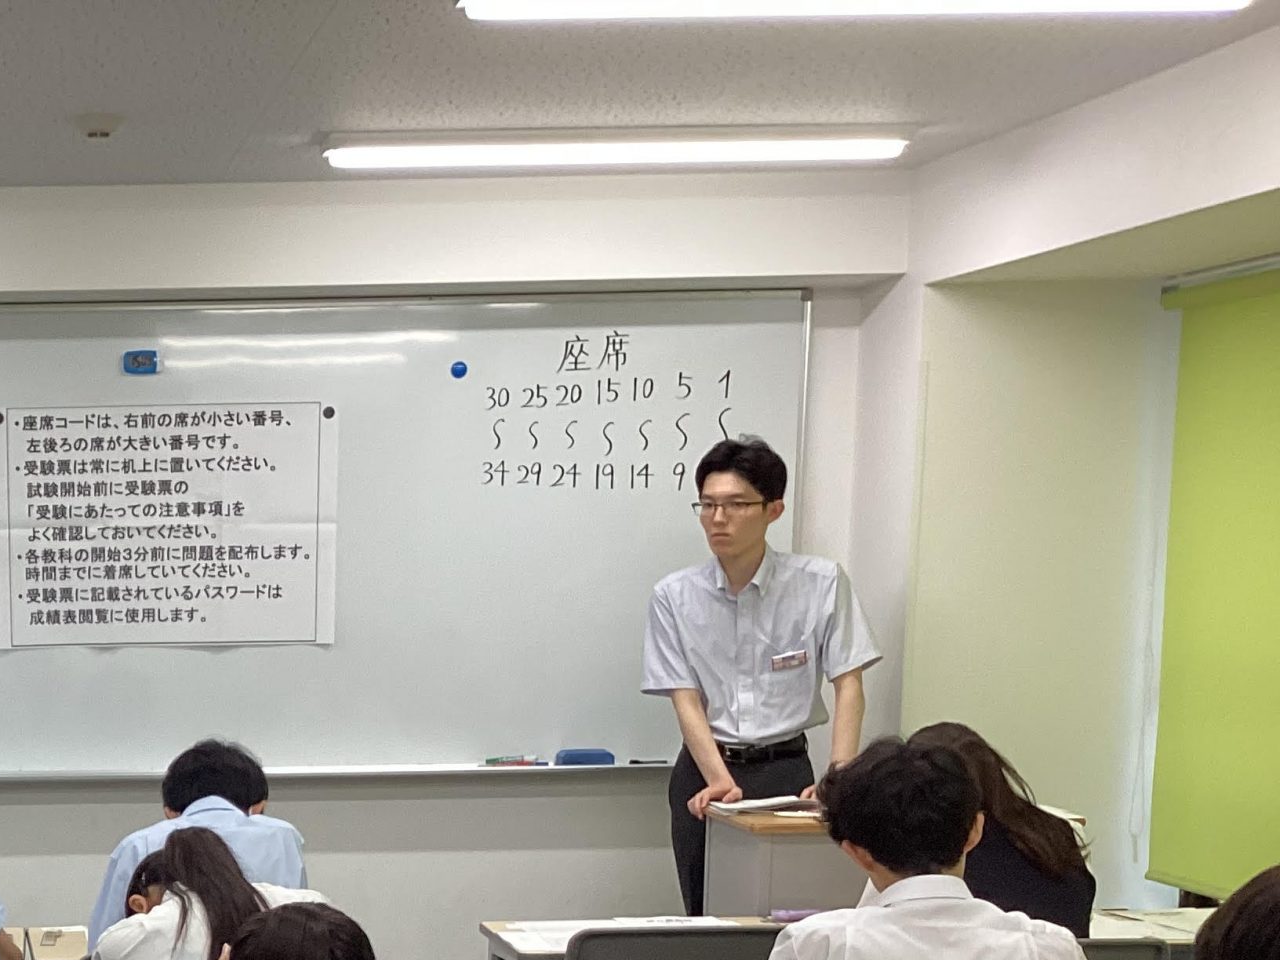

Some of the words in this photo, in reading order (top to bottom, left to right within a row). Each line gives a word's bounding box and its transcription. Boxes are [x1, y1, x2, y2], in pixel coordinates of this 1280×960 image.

[557, 330, 630, 374] 座席
[485, 386, 510, 411] 30
[521, 383, 549, 409] 25
[555, 383, 583, 408] 20
[596, 377, 621, 406] 15
[632, 376, 655, 402] 10
[677, 371, 694, 400] 5
[26, 433, 239, 453] 左後ろの席が大きい番号です。
[482, 460, 510, 487] 34
[516, 462, 542, 487] 29
[549, 463, 582, 488] 24
[595, 463, 615, 490] 19
[630, 463, 655, 490] 14
[26, 480, 189, 498] 試験開始前に受験票の
[28, 524, 217, 542] よく確認しておいてください。
[25, 563, 250, 581] 時間までに着席していてください。
[30, 607, 206, 626] 成績表閲覧に使用します。
